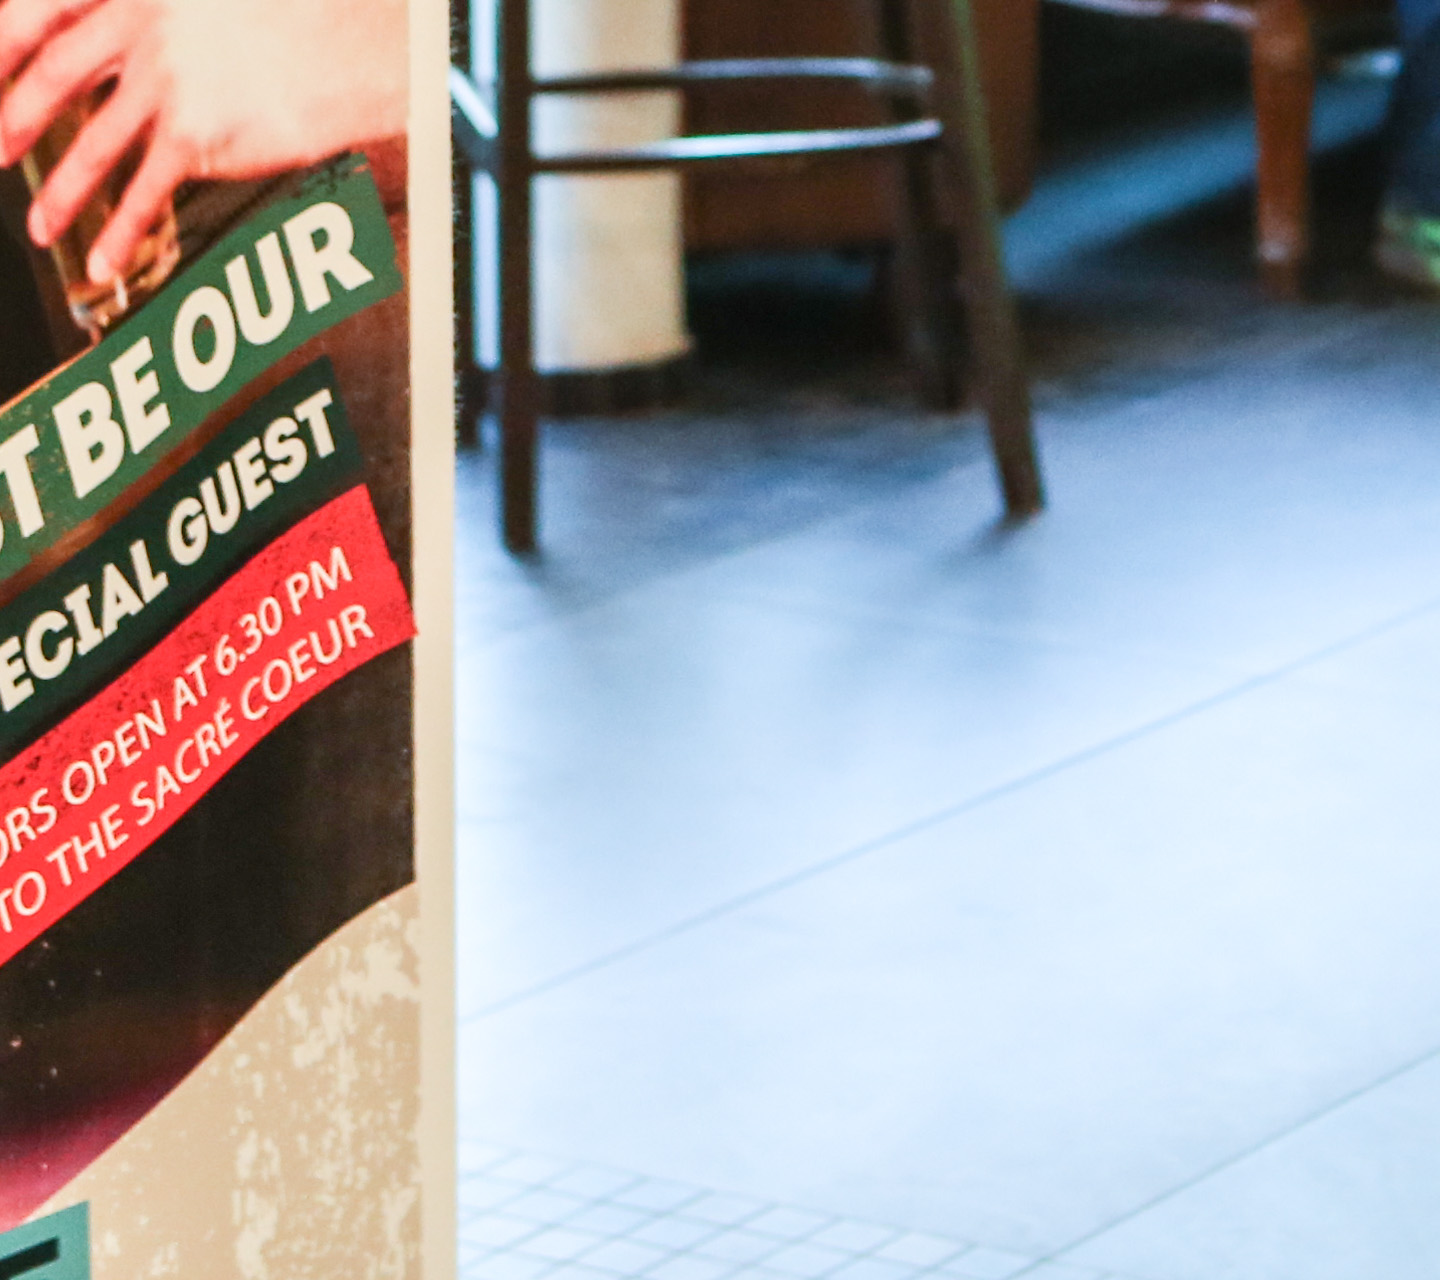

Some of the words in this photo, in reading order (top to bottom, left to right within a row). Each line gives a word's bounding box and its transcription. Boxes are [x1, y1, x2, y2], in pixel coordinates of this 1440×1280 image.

[53, 336, 171, 499] BE
[172, 201, 373, 393] OUR
[167, 388, 340, 565] GUEST
[47, 805, 128, 887] THE
[130, 698, 240, 826] SACRÉ
[239, 603, 374, 723] COEUR
[63, 701, 167, 805] OPEN
[172, 655, 209, 720] AT
[215, 596, 283, 675] 6.30
[284, 547, 353, 614] PM
